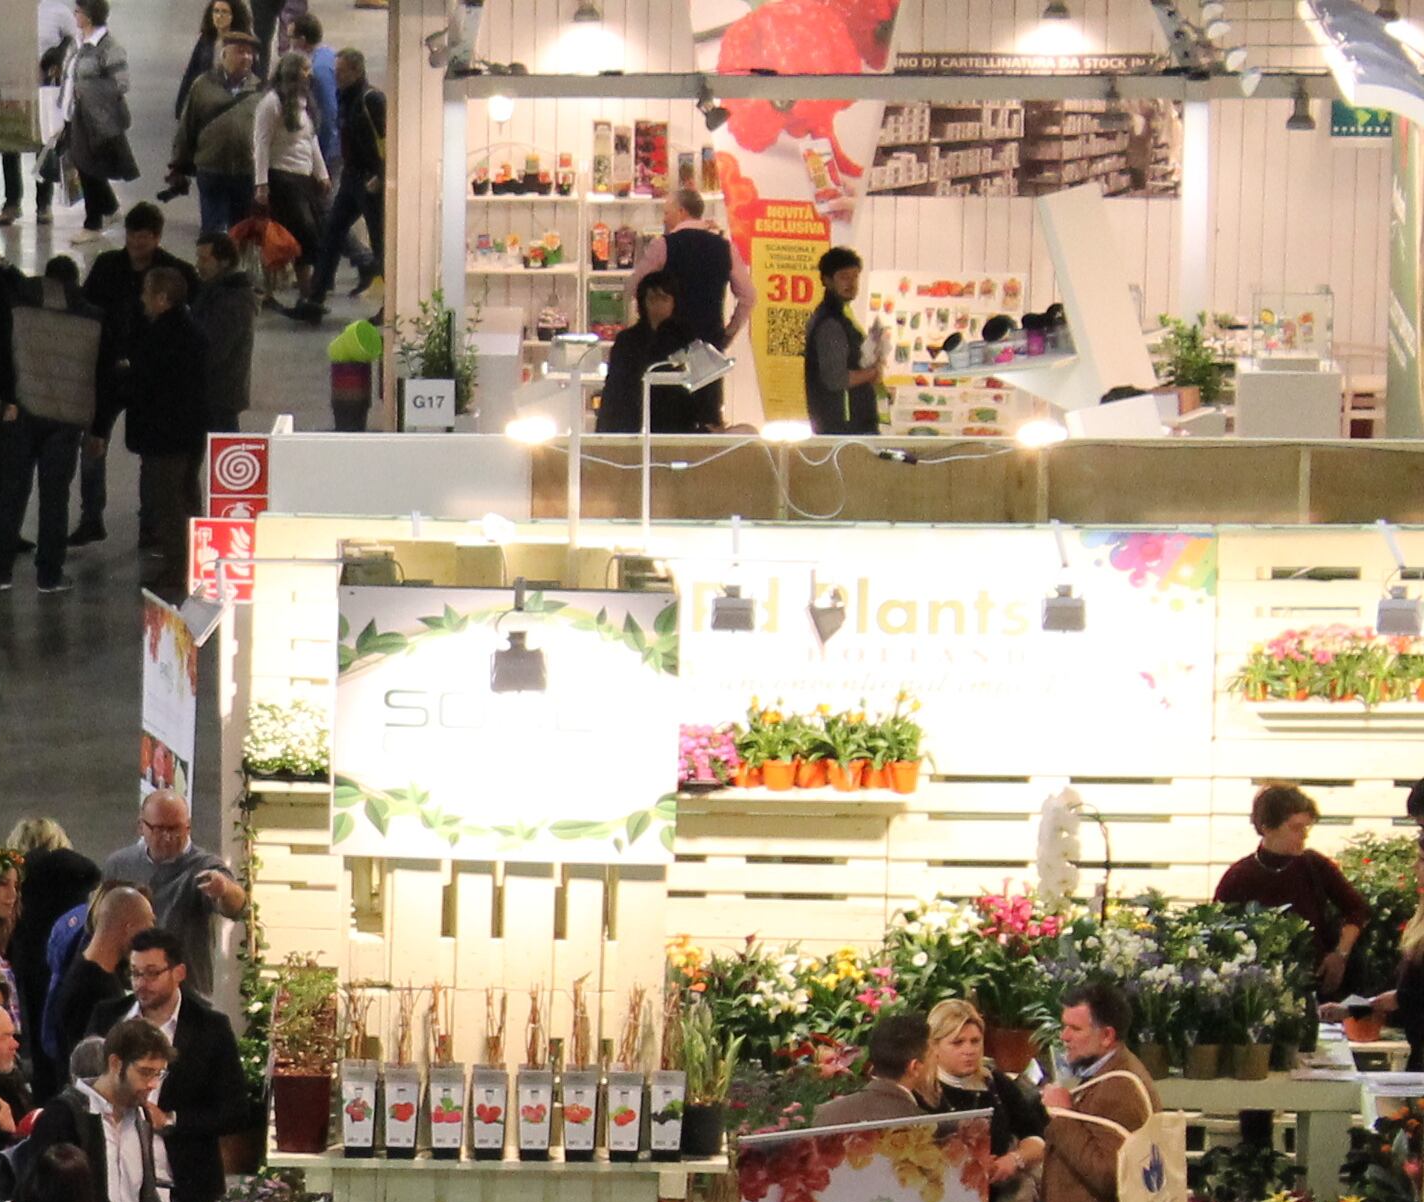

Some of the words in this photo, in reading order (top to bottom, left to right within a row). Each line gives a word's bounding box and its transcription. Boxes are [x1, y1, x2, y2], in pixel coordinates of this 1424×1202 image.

[922, 57, 937, 68] DI
[1083, 58, 1127, 69] STOCK
[767, 274, 814, 304] 3D
[412, 394, 445, 409] G17
